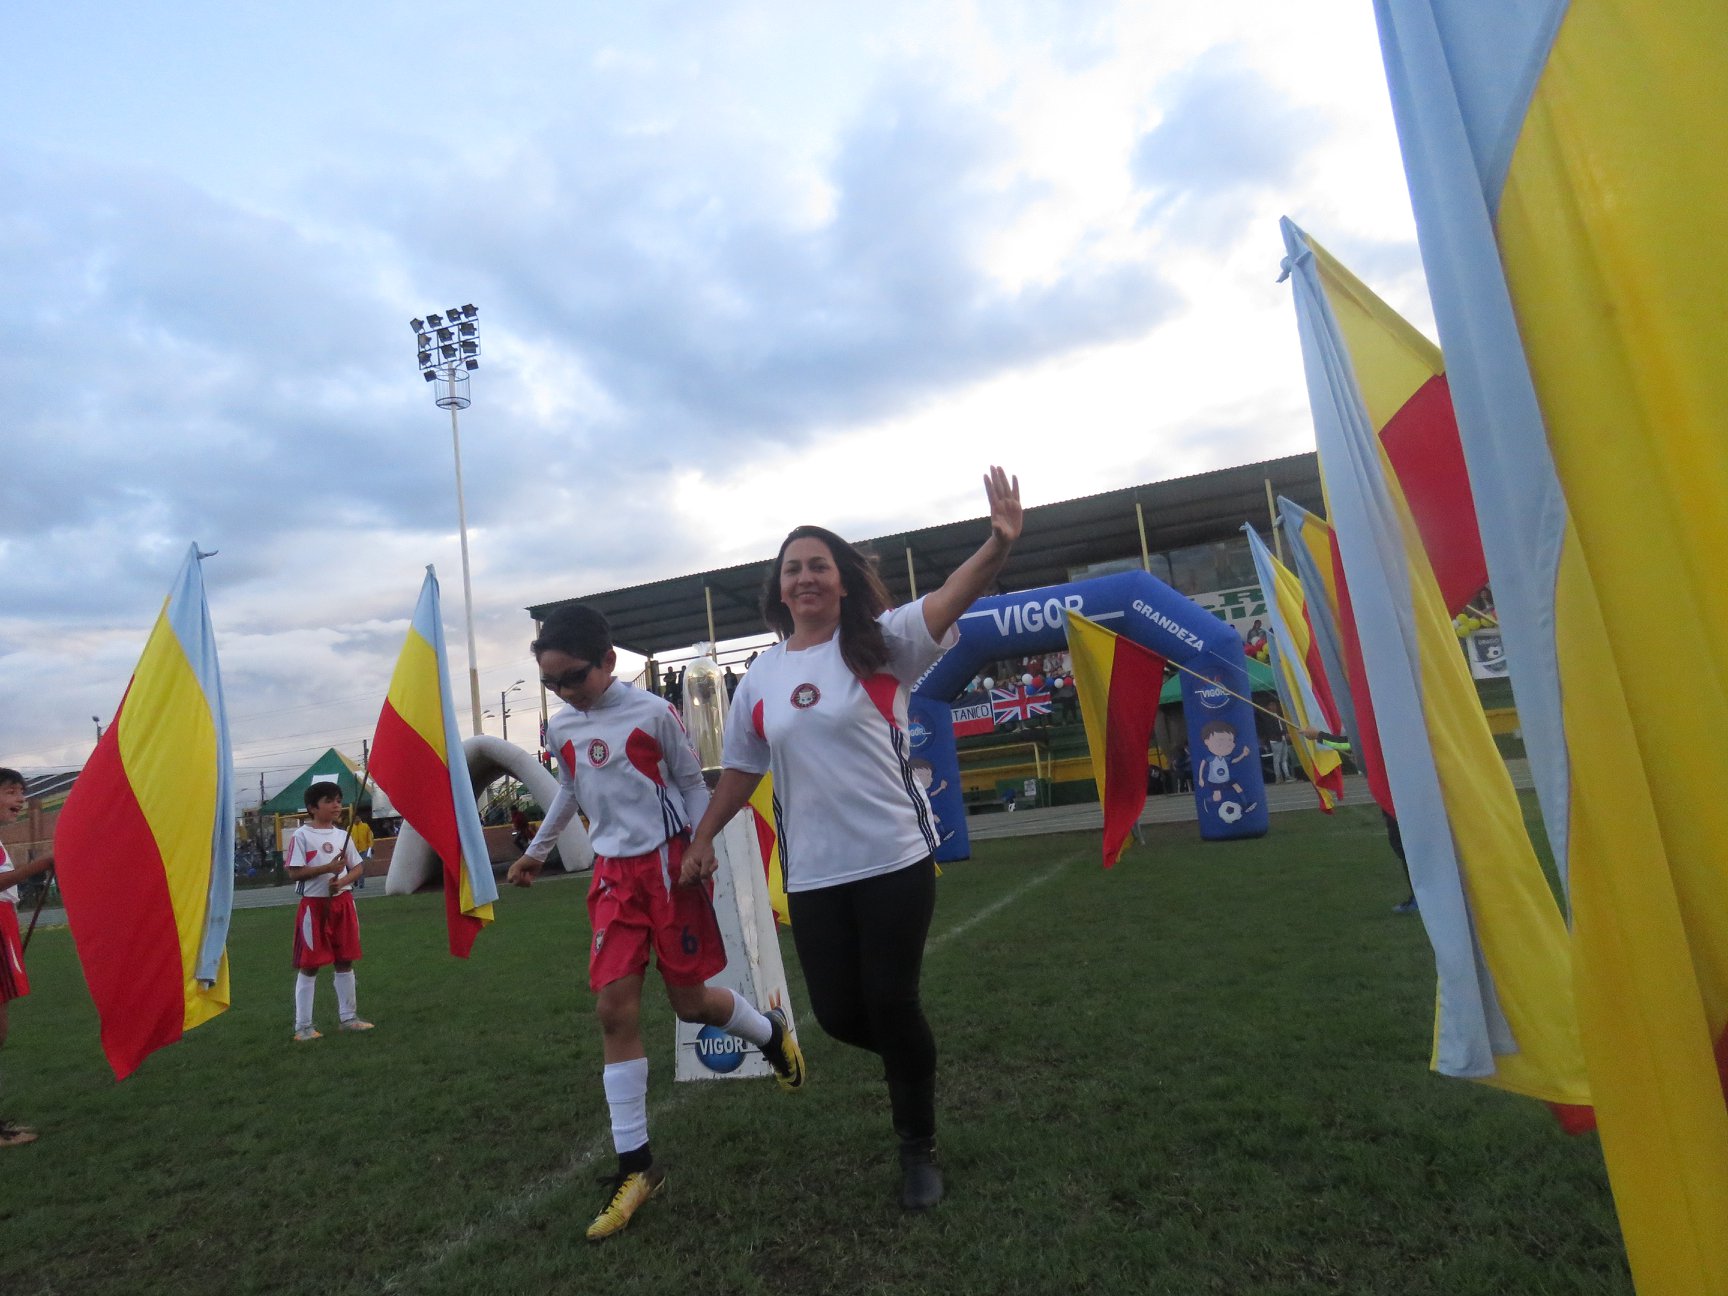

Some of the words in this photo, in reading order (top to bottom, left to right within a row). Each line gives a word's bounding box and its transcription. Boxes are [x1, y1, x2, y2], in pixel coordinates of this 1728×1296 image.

[1132, 599, 1205, 652] GRANDEZA
[682, 926, 699, 956] 6
[698, 1035, 743, 1056] VIGOR
